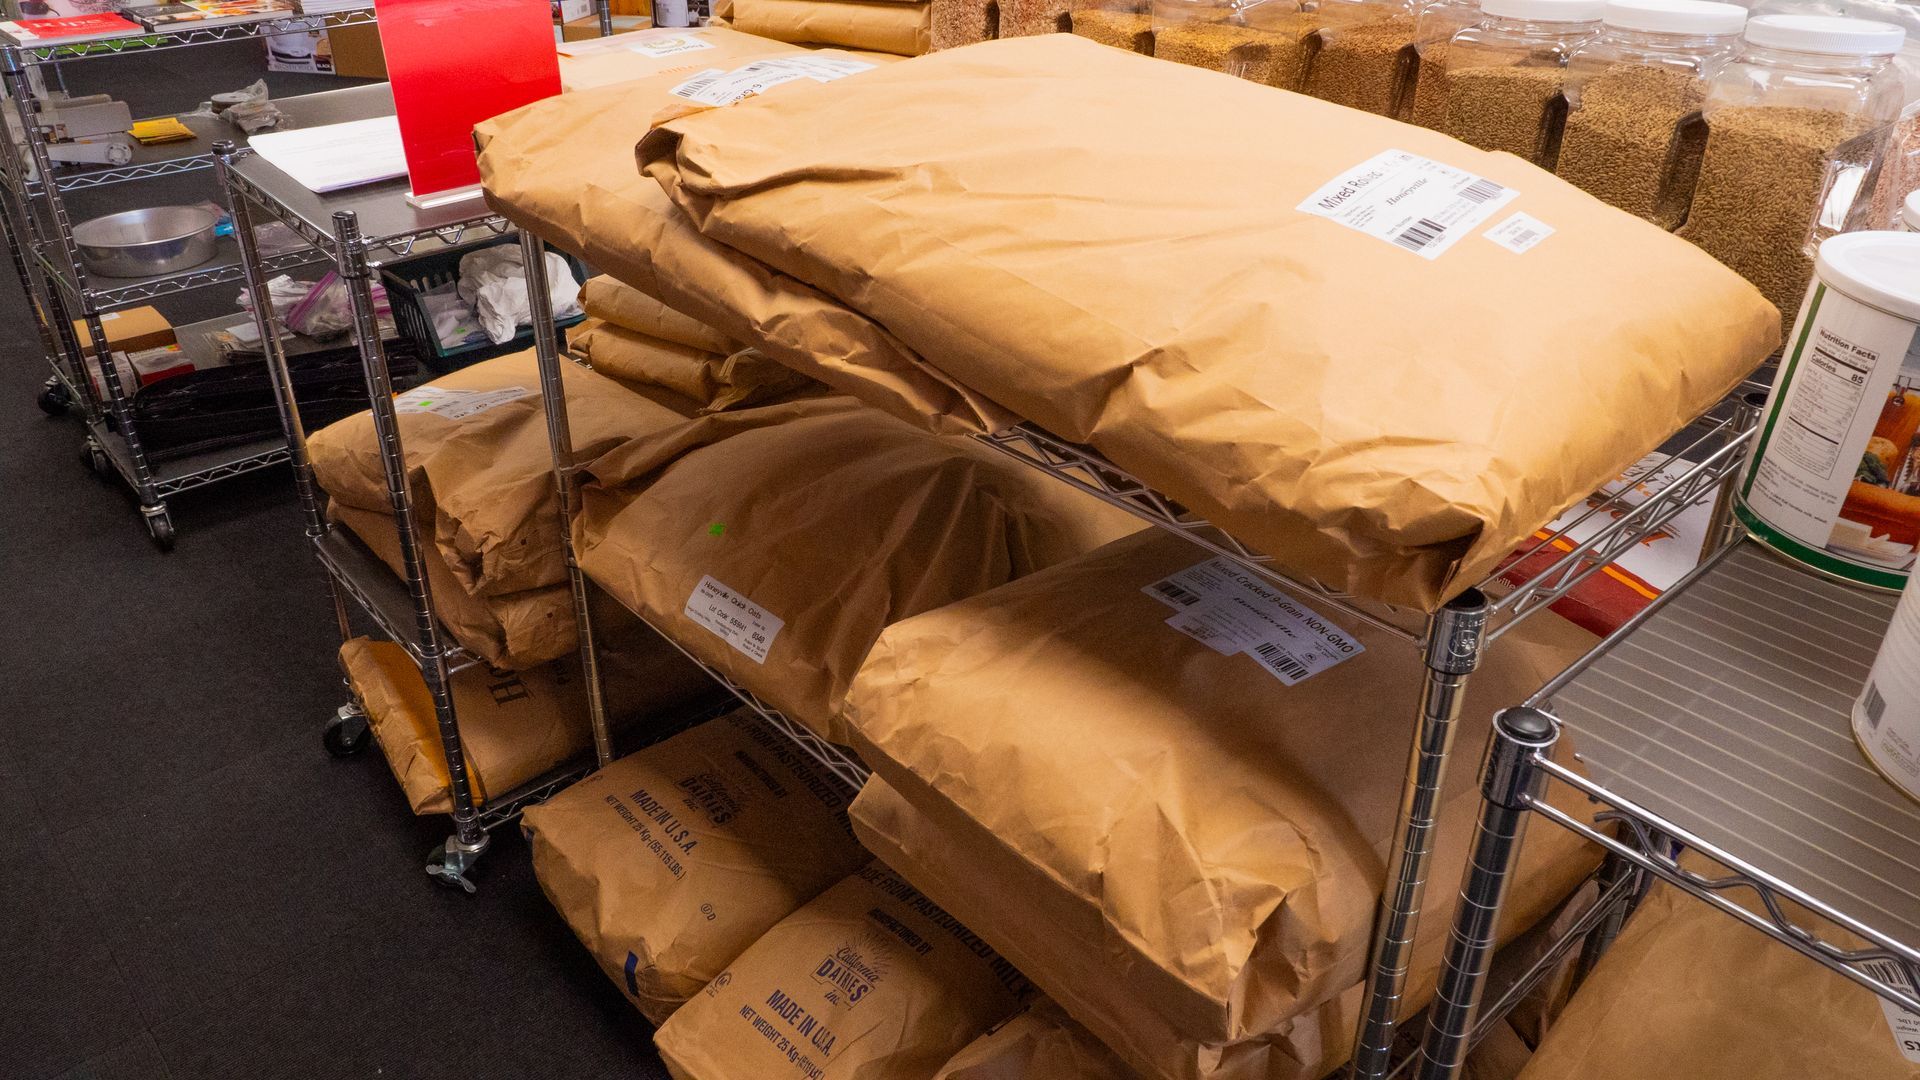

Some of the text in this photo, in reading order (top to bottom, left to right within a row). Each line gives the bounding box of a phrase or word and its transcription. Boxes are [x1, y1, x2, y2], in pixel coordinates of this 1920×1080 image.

[1318, 187, 1356, 210] Mixed
[1385, 178, 1427, 206] Honeyville
[1820, 330, 1850, 350] Nutrition
[1851, 346, 1876, 361] Facts
[1812, 354, 1837, 373] Calories
[1851, 373, 1865, 384] 85
[704, 581, 730, 600] Honeyville
[731, 597, 746, 609] Quick
[747, 606, 762, 620] Oats
[1236, 576, 1274, 599] Cracked
[1268, 597, 1304, 619] 9-Grain
[1302, 616, 1354, 653] NON-GMO
[776, 747, 842, 808] PASTEURIZED
[613, 801, 639, 829] WEIGHT
[679, 776, 732, 824] DAIRIES
[630, 789, 698, 856] MADE IN U.S.A.
[880, 874, 916, 902] FROM
[909, 895, 995, 959] PASTEURIZED
[836, 947, 880, 983] California
[915, 941, 934, 956] BY
[816, 957, 869, 1002] DAIRIES
[739, 1004, 757, 1021] NET
[752, 1014, 782, 1043] WEIGHT
[776, 1037, 790, 1052] 25
[766, 989, 805, 1026] MADE
[796, 1014, 818, 1038] IN
